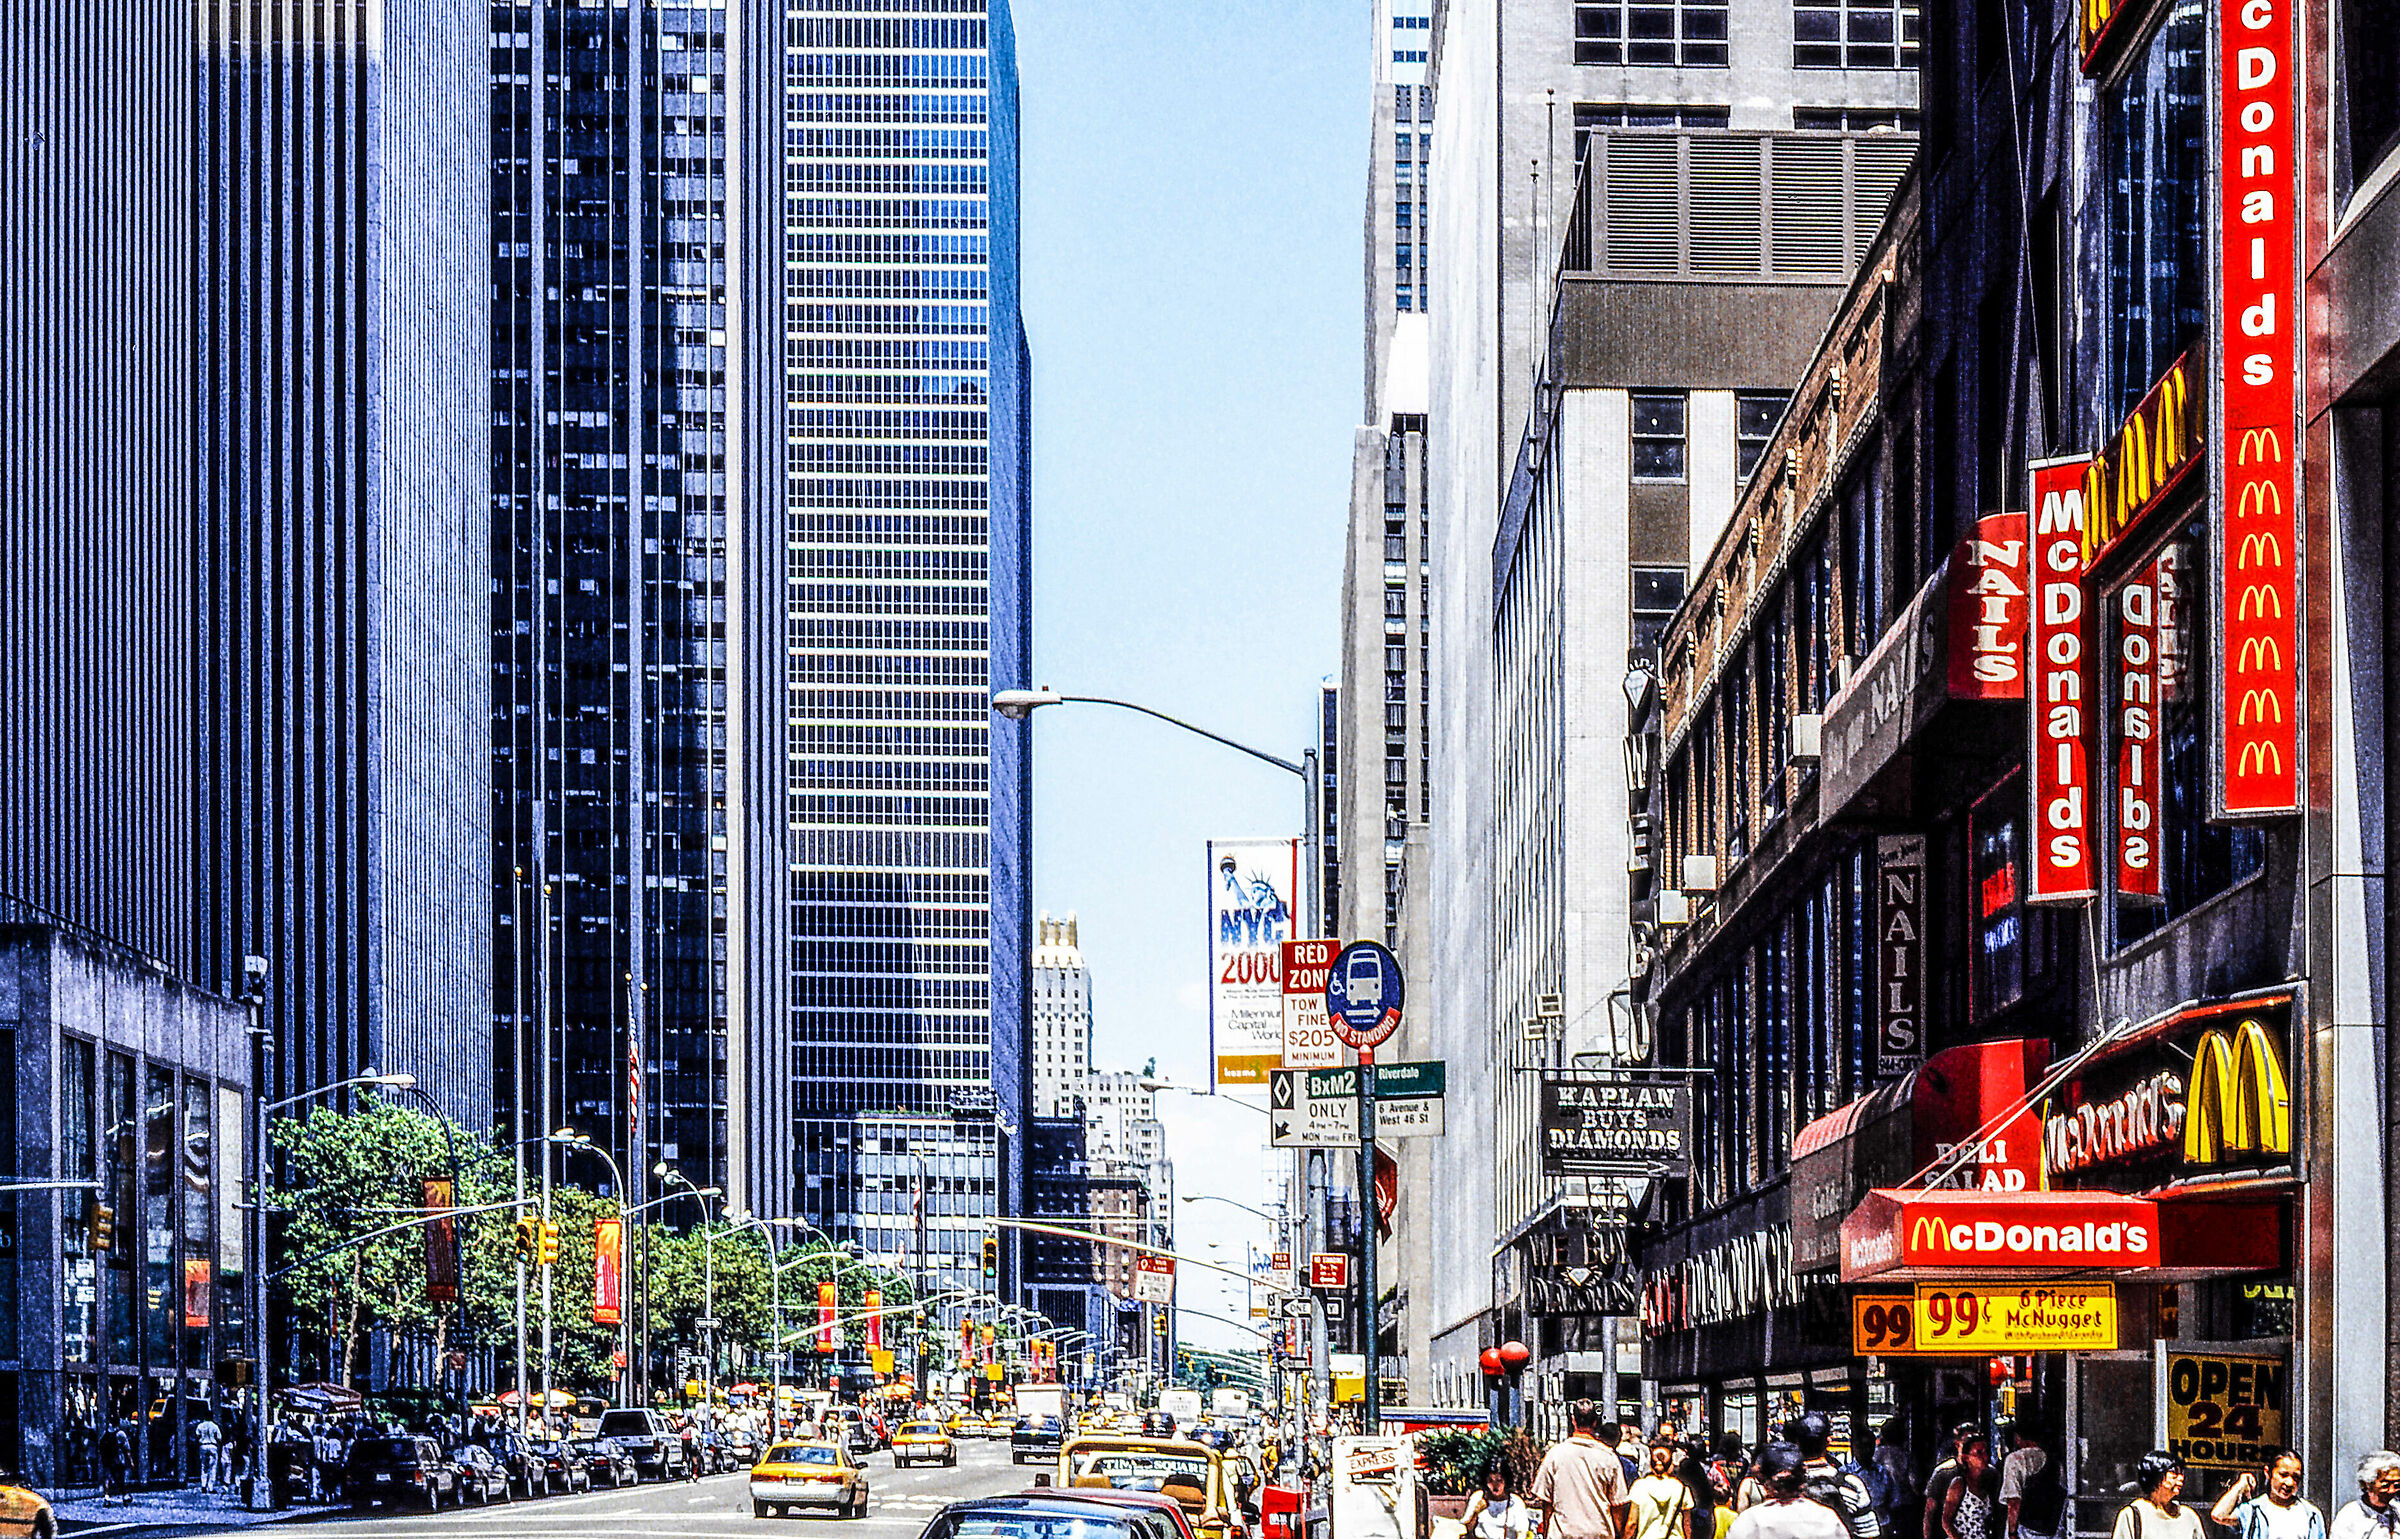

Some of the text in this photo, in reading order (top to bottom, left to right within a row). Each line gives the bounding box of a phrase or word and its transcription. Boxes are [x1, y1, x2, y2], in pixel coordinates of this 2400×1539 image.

[1967, 540, 2024, 682] NAILS
[2038, 488, 2083, 868] McDonalds
[1221, 908, 1283, 946] NYC
[1294, 944, 1328, 964] RED
[1885, 873, 1916, 1050] NAILS
[1291, 998, 1318, 1011] TOW
[1228, 1019, 1267, 1030] Capital
[1298, 1013, 1327, 1025] FINE
[1289, 1029, 1335, 1047] $205
[1333, 1015, 1395, 1045] NO STANDING
[1291, 1051, 1335, 1061] MINIMUM
[1378, 1066, 1420, 1080] Riverdale
[1311, 1070, 1356, 1097] BxM2
[1379, 1101, 1430, 1114] 6 Avenue &
[1557, 1086, 1676, 1109] KAPLAN
[1309, 1102, 1347, 1118] ONLY
[1379, 1113, 1429, 1126] West 46 St
[1581, 1109, 1648, 1129] BUYS
[1302, 1132, 1320, 1142] MON
[1548, 1128, 1682, 1151] DIAMONDS
[1935, 1139, 2008, 1165] DELI
[1924, 1168, 2026, 1191] SALAD
[1911, 1216, 2148, 1253] McDonald's
[1290, 1304, 1307, 1313] ONE
[2020, 1289, 2087, 1308] 6 Piece
[1863, 1304, 1911, 1348] 99
[2006, 1308, 2102, 1329] McNugget
[2170, 1357, 2282, 1411] OPEN
[2188, 1400, 2264, 1442] 24
[1154, 1460, 1207, 1475] SQUARE
[1350, 1452, 1396, 1470] EXPRESS
